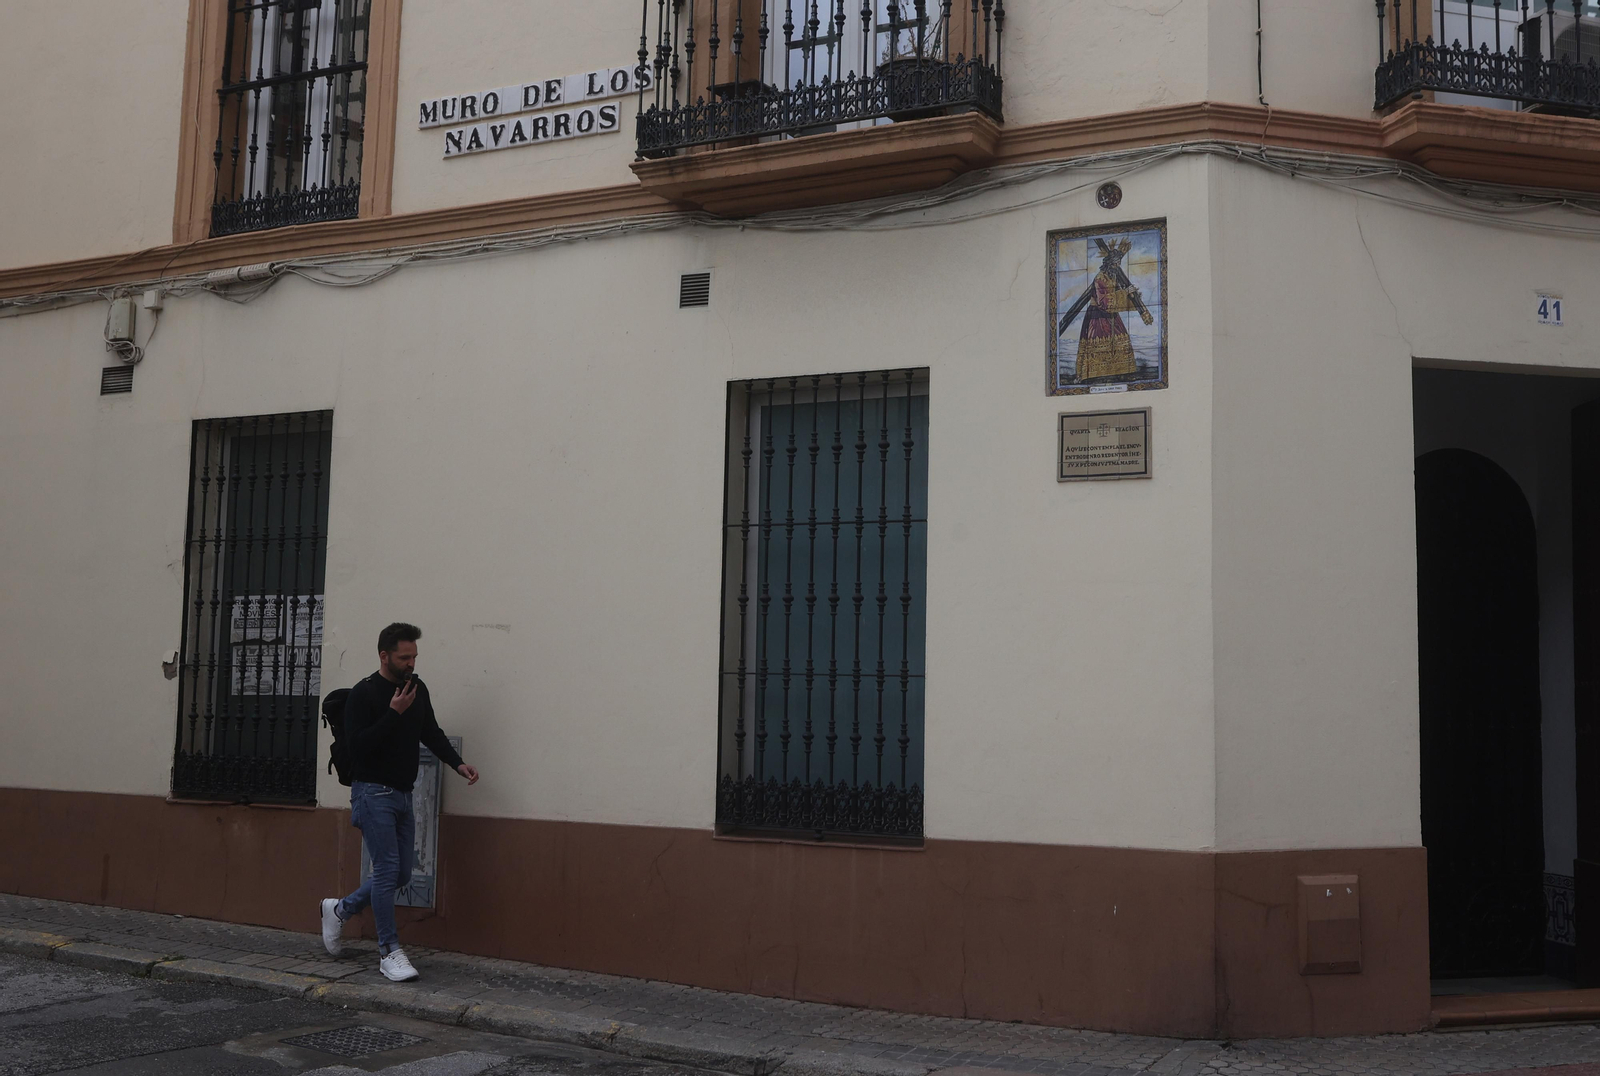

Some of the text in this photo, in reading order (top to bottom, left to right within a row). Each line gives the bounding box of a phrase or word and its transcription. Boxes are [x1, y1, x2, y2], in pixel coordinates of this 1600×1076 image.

[419, 63, 651, 124] MURO DE LOS
[444, 105, 617, 154] NAVARROS
[1538, 299, 1560, 321] 41
